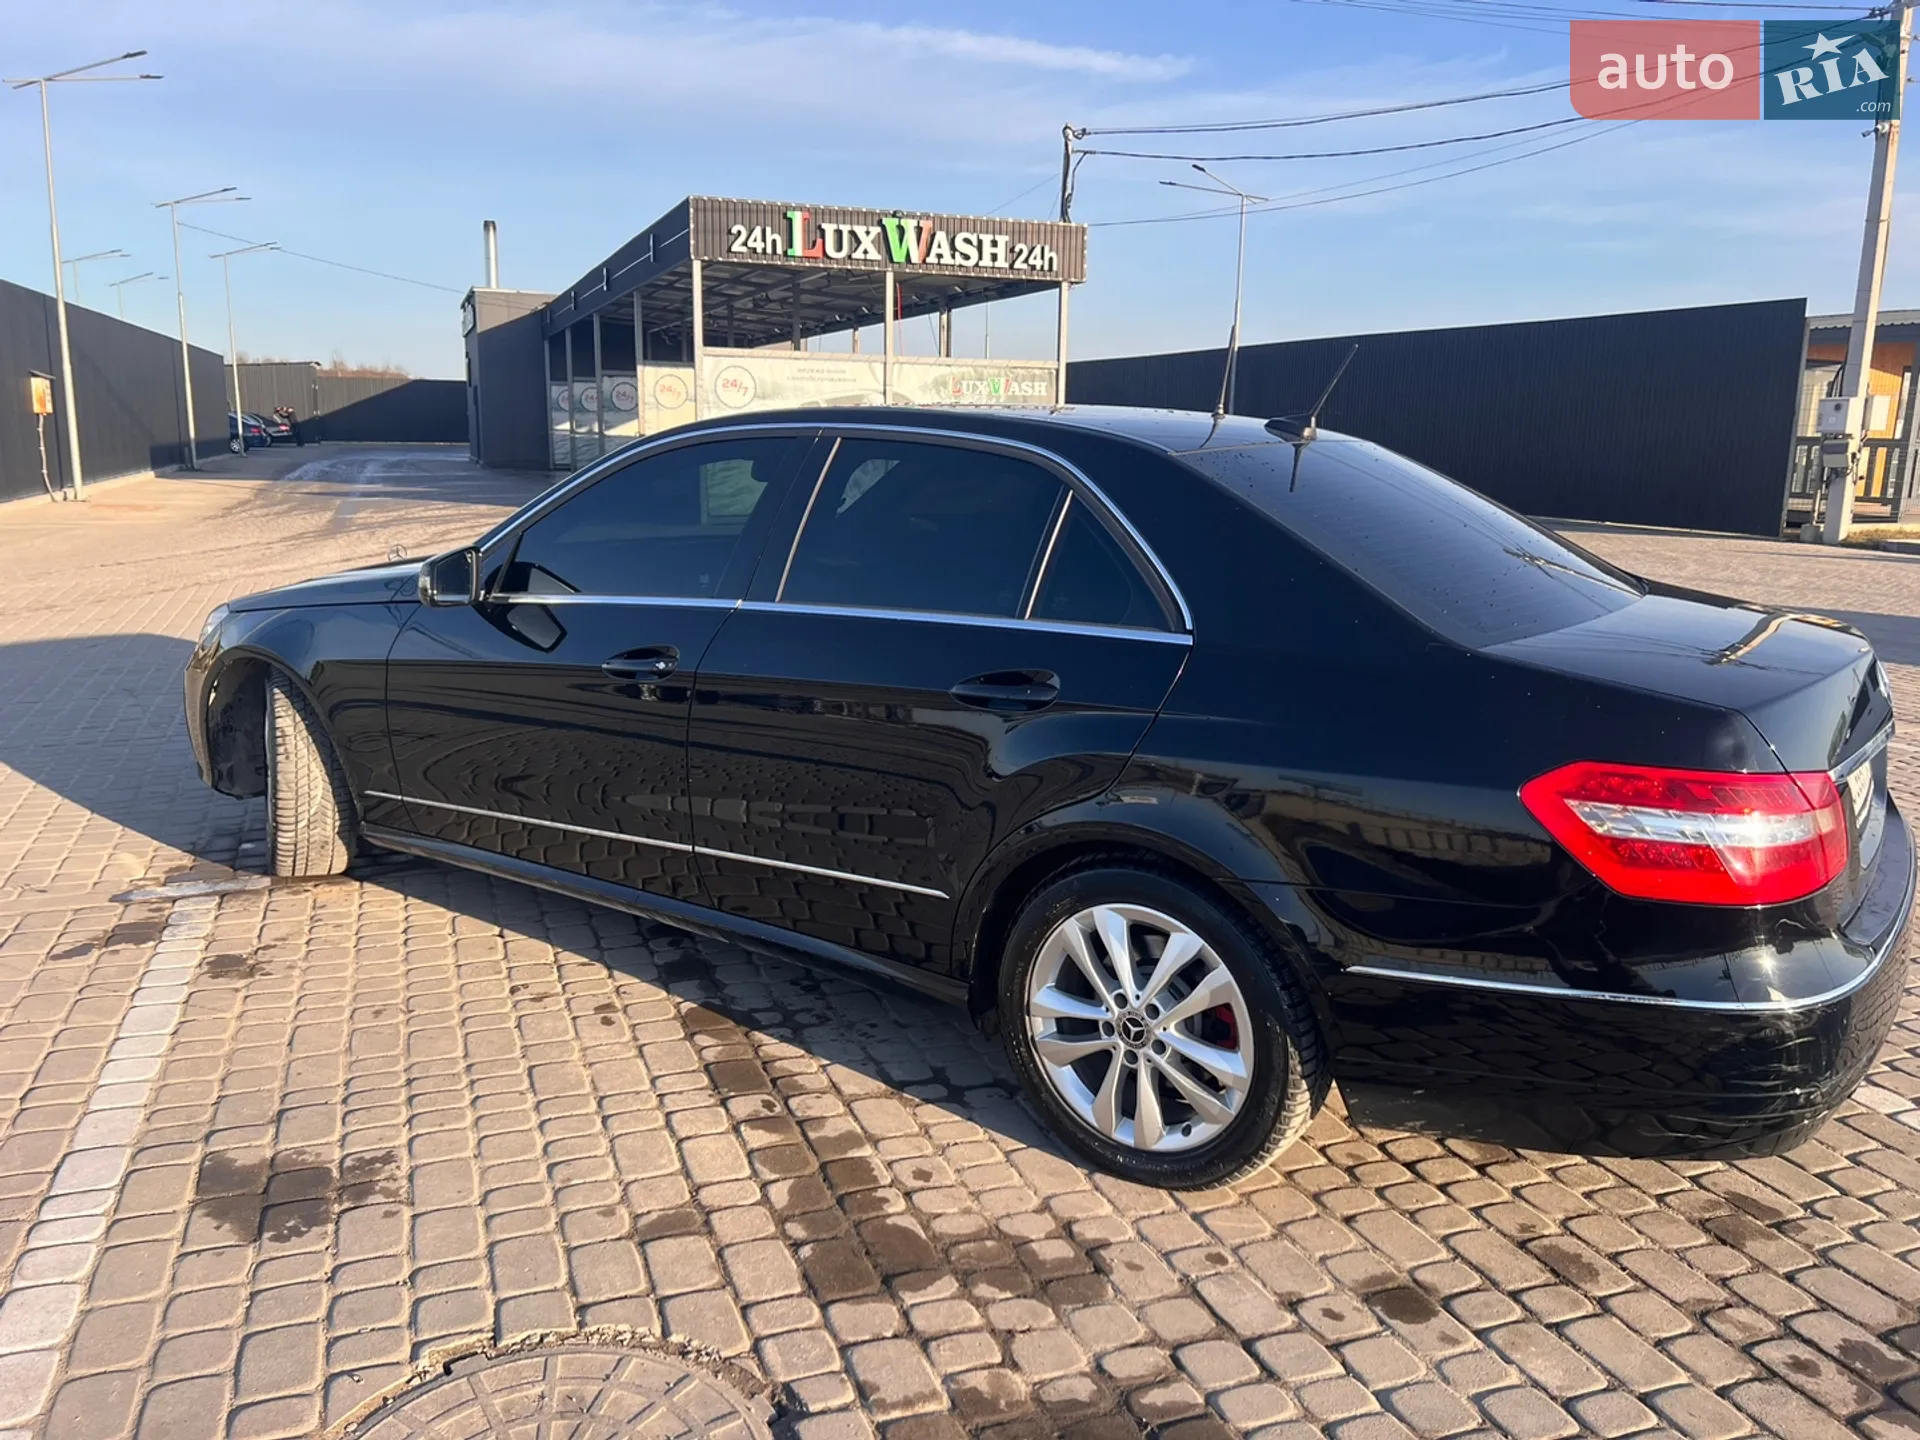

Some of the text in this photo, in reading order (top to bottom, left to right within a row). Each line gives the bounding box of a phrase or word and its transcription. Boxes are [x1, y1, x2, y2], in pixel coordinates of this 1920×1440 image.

[729, 223, 783, 255] 24h
[1013, 242, 1058, 272] 24h
[721, 377, 749, 396] 24/7
